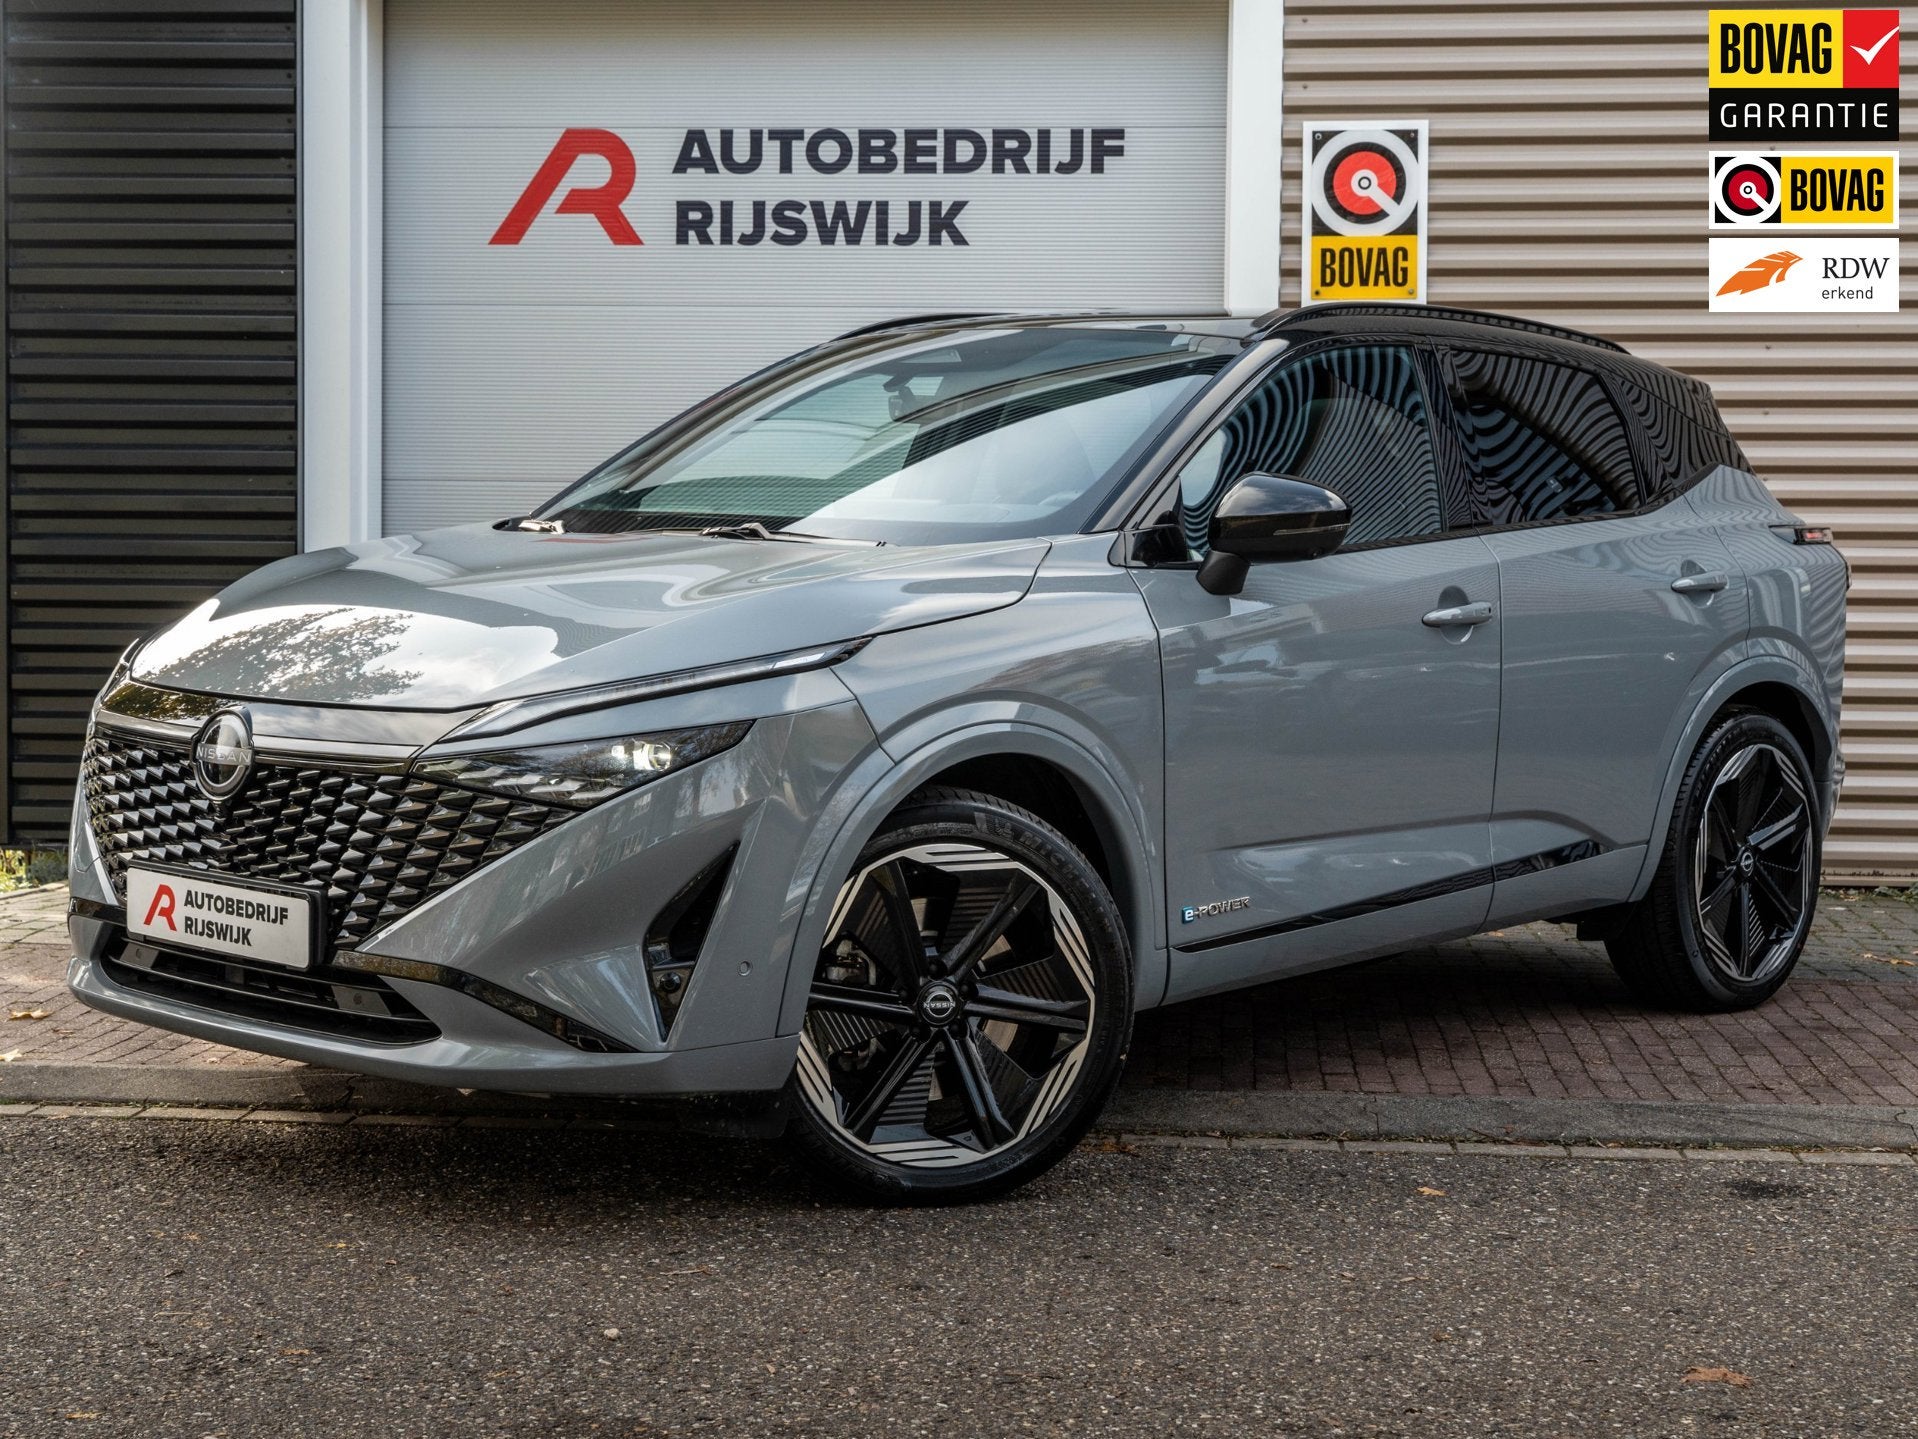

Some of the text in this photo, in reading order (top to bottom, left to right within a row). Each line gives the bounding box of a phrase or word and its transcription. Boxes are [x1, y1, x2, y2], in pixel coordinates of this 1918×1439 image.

[672, 128, 1126, 174] AUTOBEDRIJF
[675, 199, 970, 246] RIJSWIJK
[1320, 246, 1408, 288] BOVAG
[184, 889, 289, 925] AUTOBEDRIJF
[184, 916, 252, 946] RIJSWIJK
